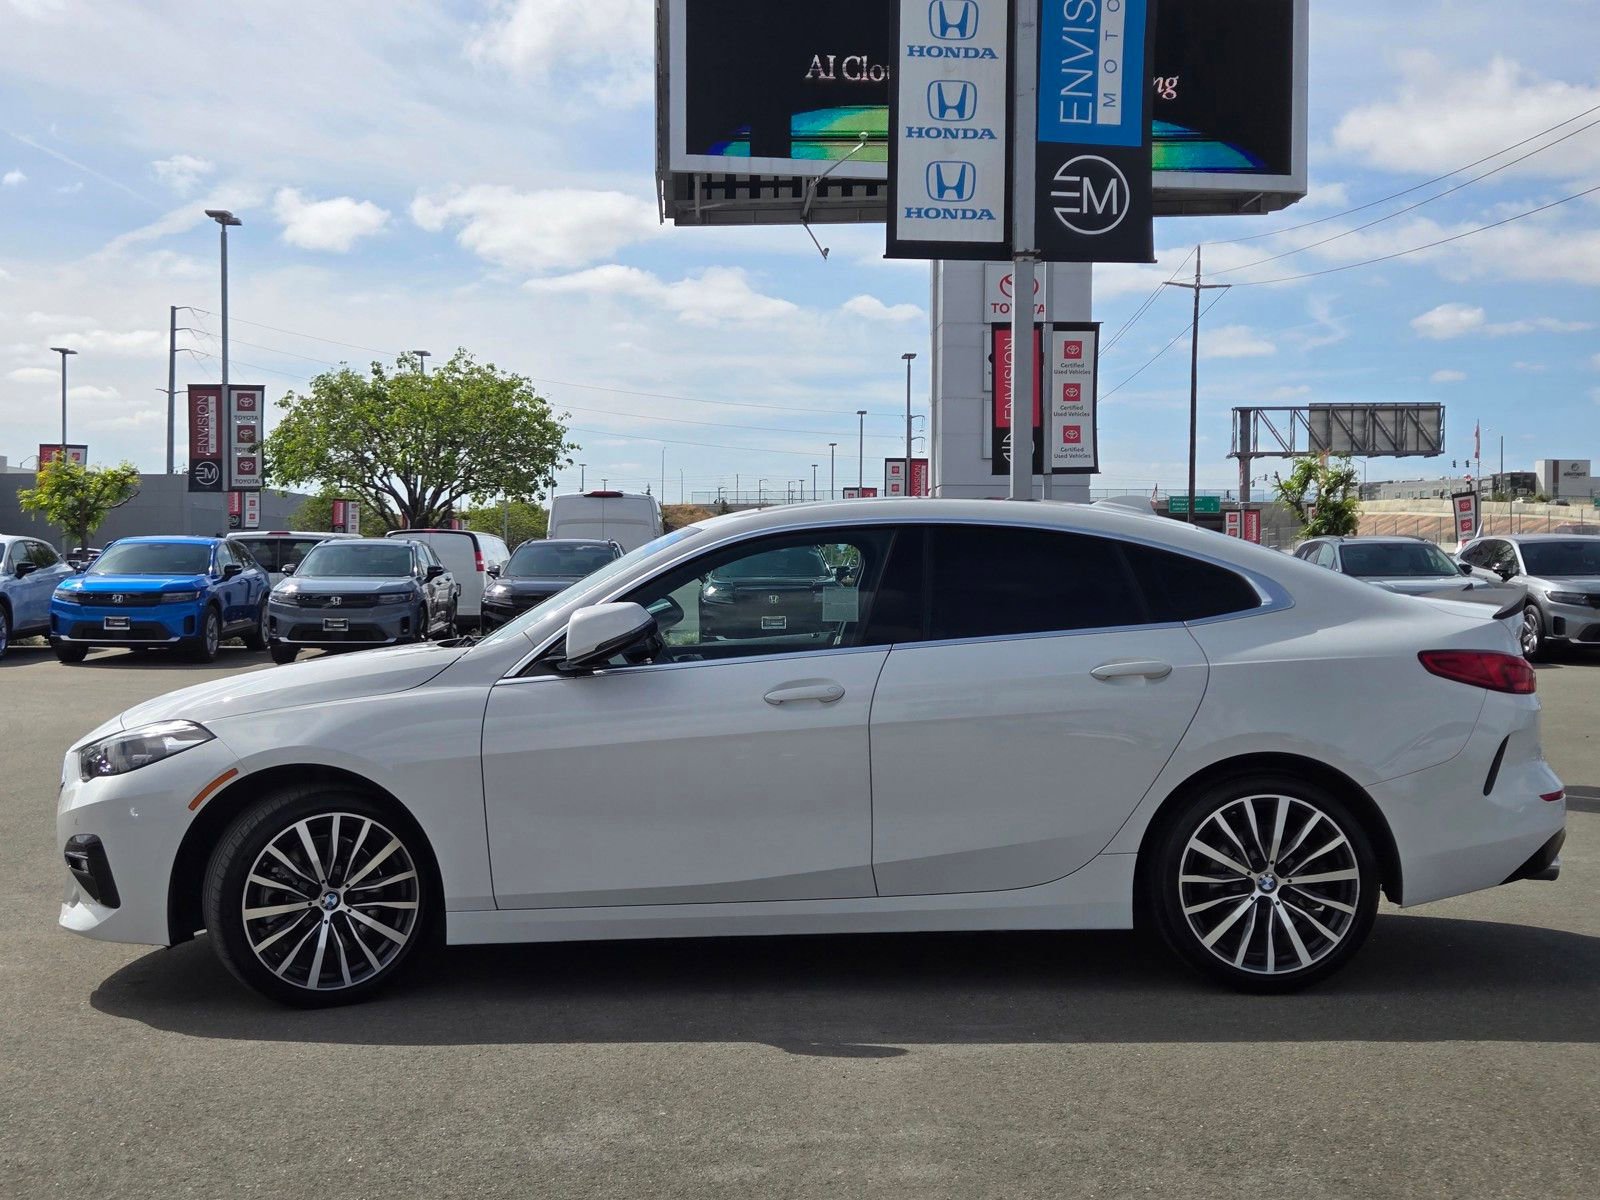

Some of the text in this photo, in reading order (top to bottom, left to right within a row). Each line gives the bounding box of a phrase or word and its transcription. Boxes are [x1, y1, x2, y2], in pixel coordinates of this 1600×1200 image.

[907, 45, 999, 59] HONDA
[1060, 0, 1096, 124] ENVIS
[1103, 0, 1120, 108] MOTO
[805, 54, 890, 81] AI Clo
[905, 126, 997, 140] HONDA
[904, 207, 996, 220] HONDA
[197, 395, 209, 454] ENVISION
